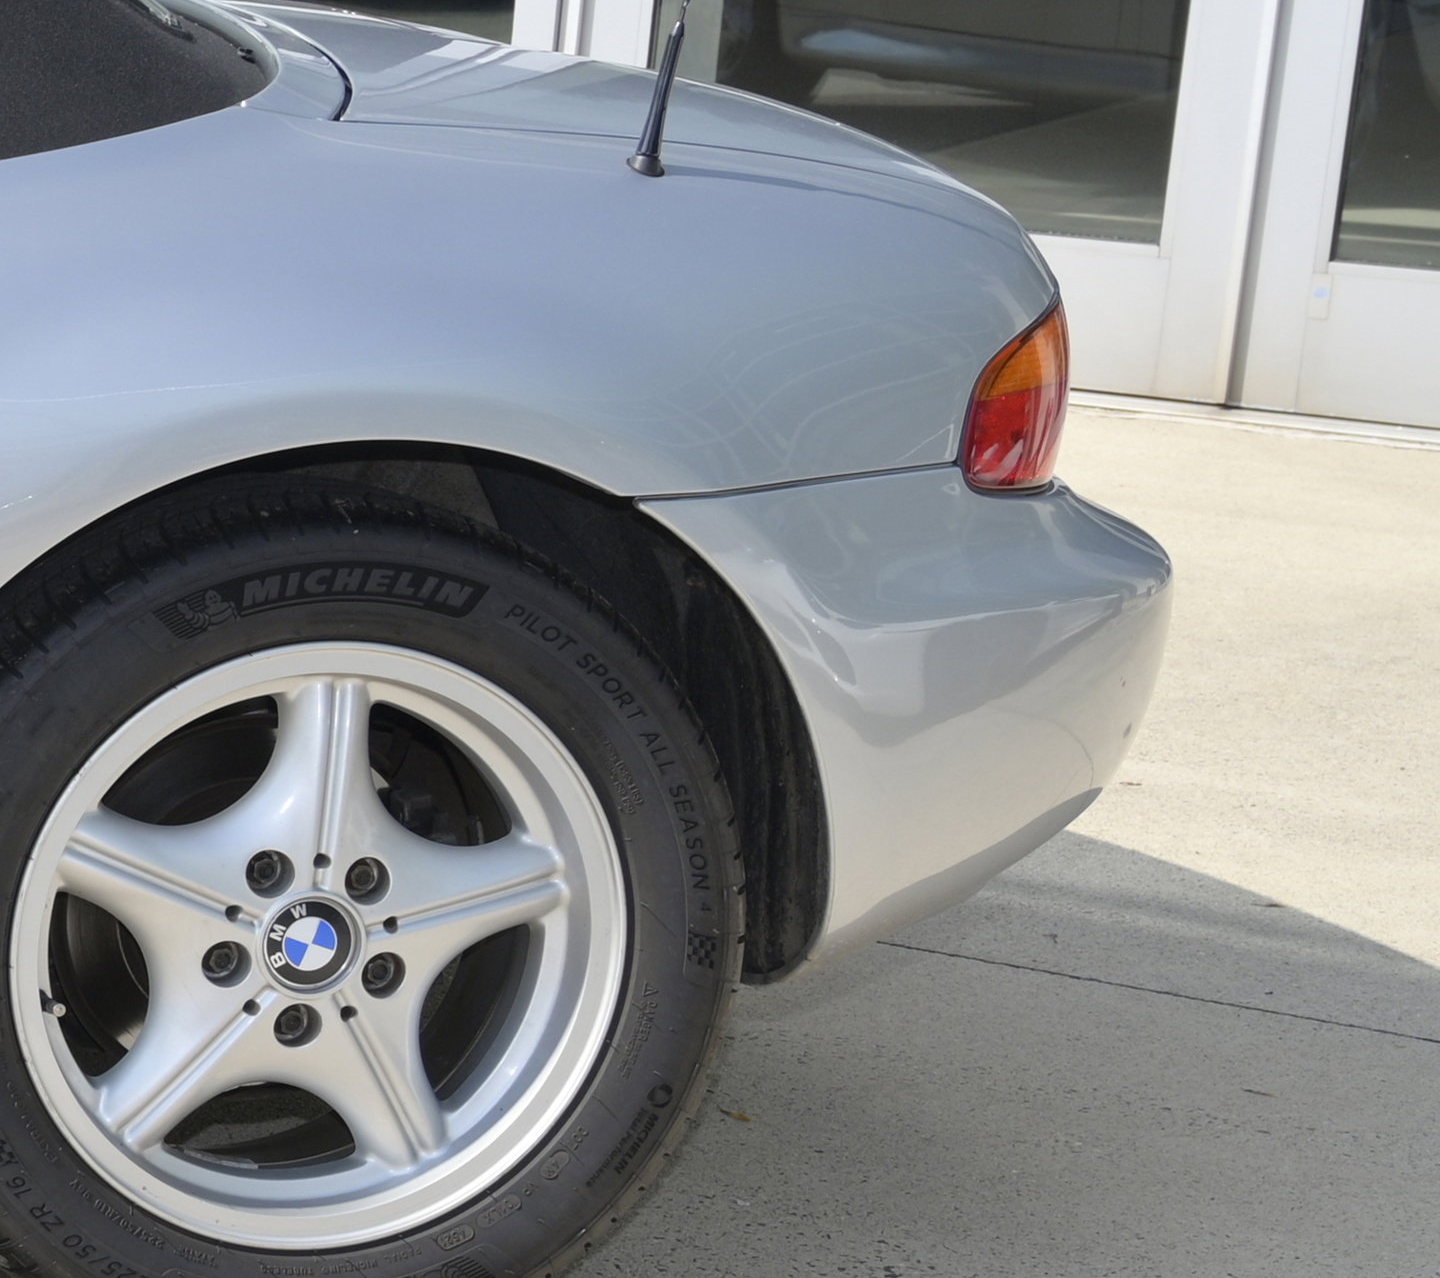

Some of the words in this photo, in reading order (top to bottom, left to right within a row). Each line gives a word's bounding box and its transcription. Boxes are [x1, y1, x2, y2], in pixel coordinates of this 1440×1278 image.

[237, 565, 476, 611] MICHELIN
[501, 599, 576, 655] PILOT
[571, 647, 648, 726] SPORT
[637, 724, 678, 776] ALL
[666, 780, 712, 891] SEASON
[269, 903, 308, 969] BMW
[612, 1111, 660, 1175] MICHELIN
[3, 1172, 34, 1203] 16
[27, 1197, 67, 1238] ZR
